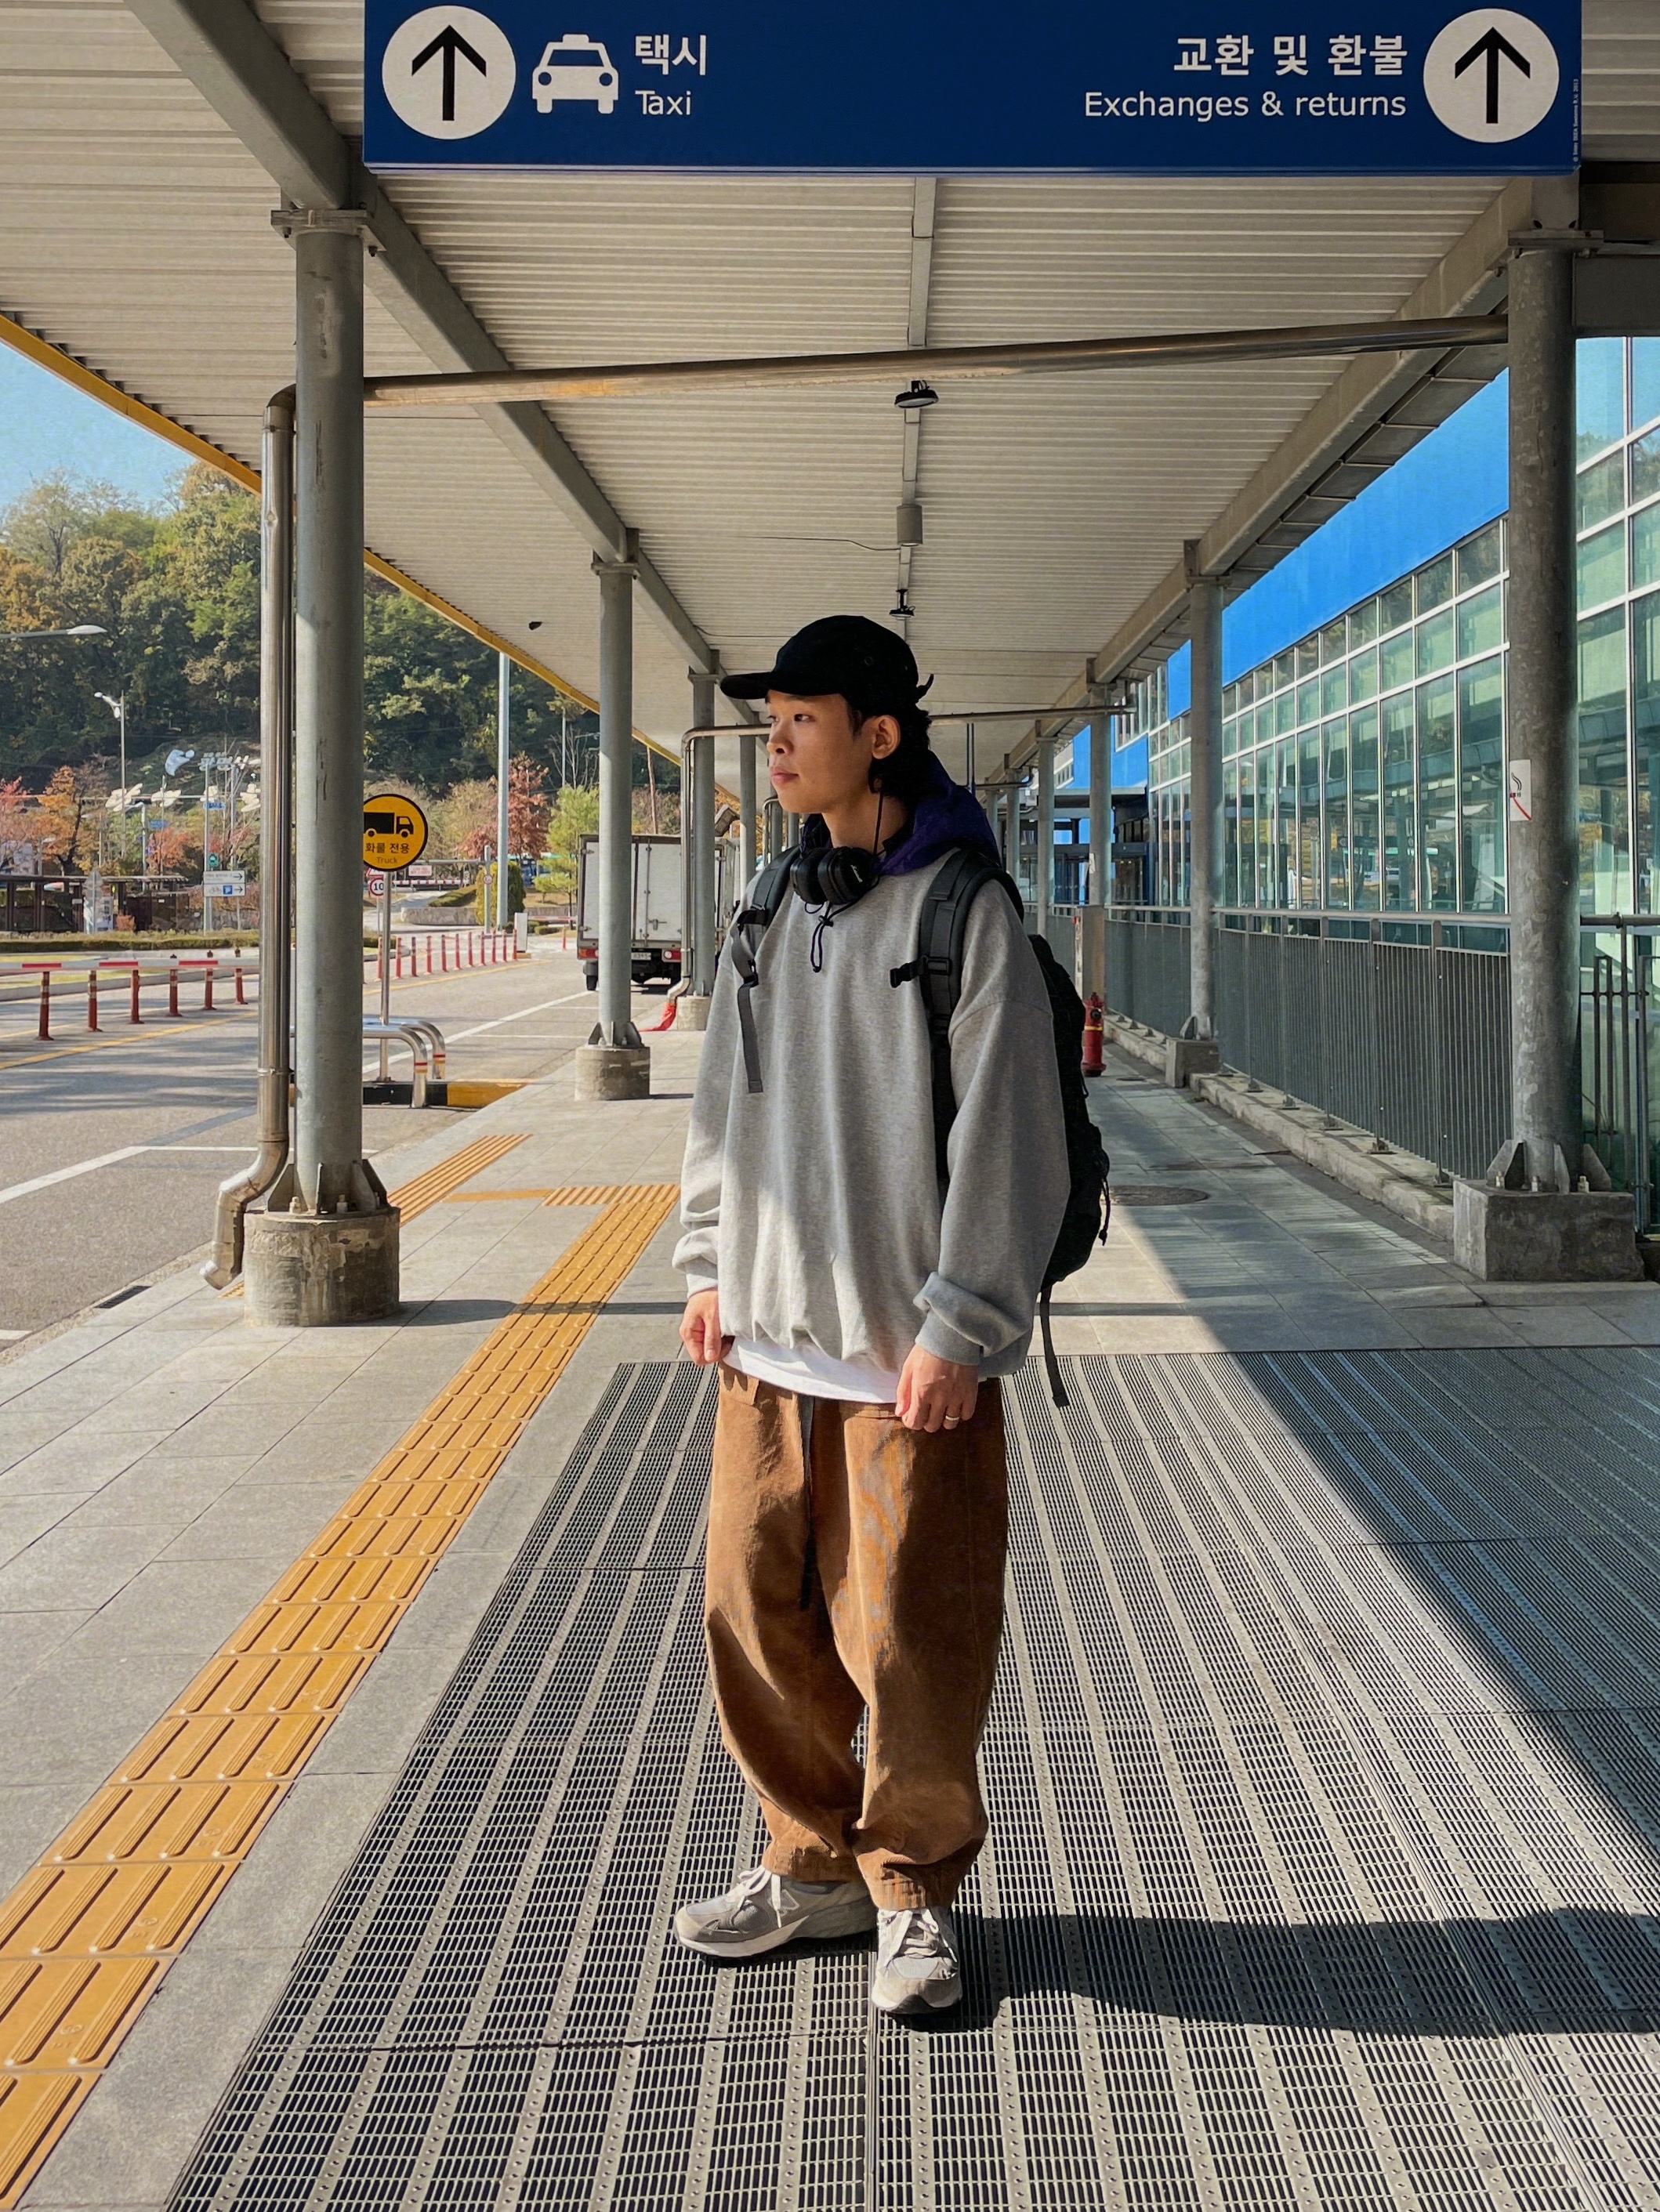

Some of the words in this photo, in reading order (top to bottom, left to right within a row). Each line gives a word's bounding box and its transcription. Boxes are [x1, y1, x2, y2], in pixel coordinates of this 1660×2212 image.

[636, 34, 707, 76] 택시
[1173, 34, 1254, 76] 교환
[1274, 34, 1309, 76] 및
[1328, 34, 1408, 76] 환불
[635, 90, 691, 115] Taxi
[1086, 90, 1249, 122] Exchanges
[1261, 91, 1284, 116] &
[1296, 92, 1406, 116] returns
[390, 842, 410, 854] 전용
[374, 882, 384, 891] 10
